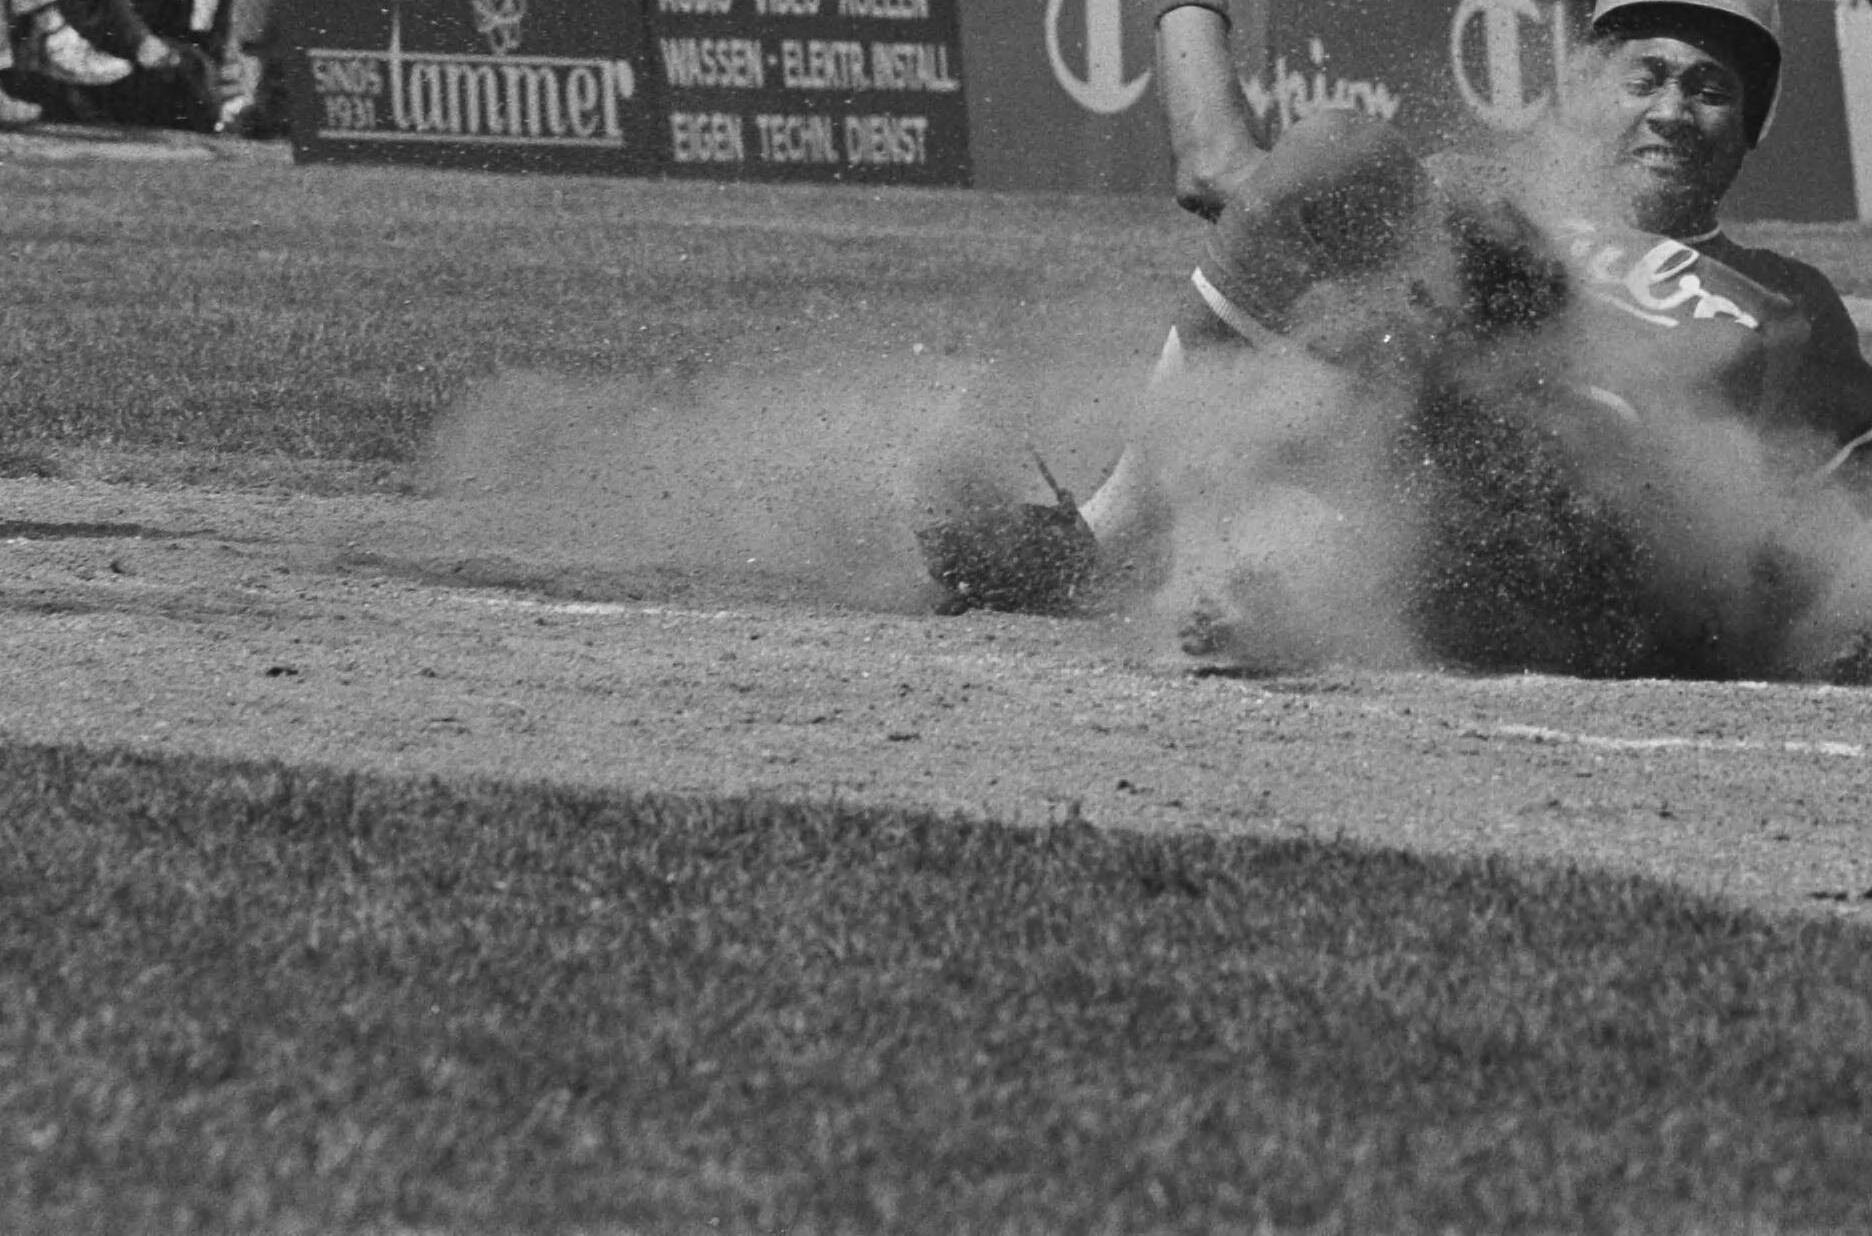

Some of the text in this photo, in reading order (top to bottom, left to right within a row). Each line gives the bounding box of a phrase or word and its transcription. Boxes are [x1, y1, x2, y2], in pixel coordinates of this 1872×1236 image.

[660, 37, 765, 88] WASSEN
[670, 112, 744, 163] EIGEN
[845, 115, 928, 164] DIENST
